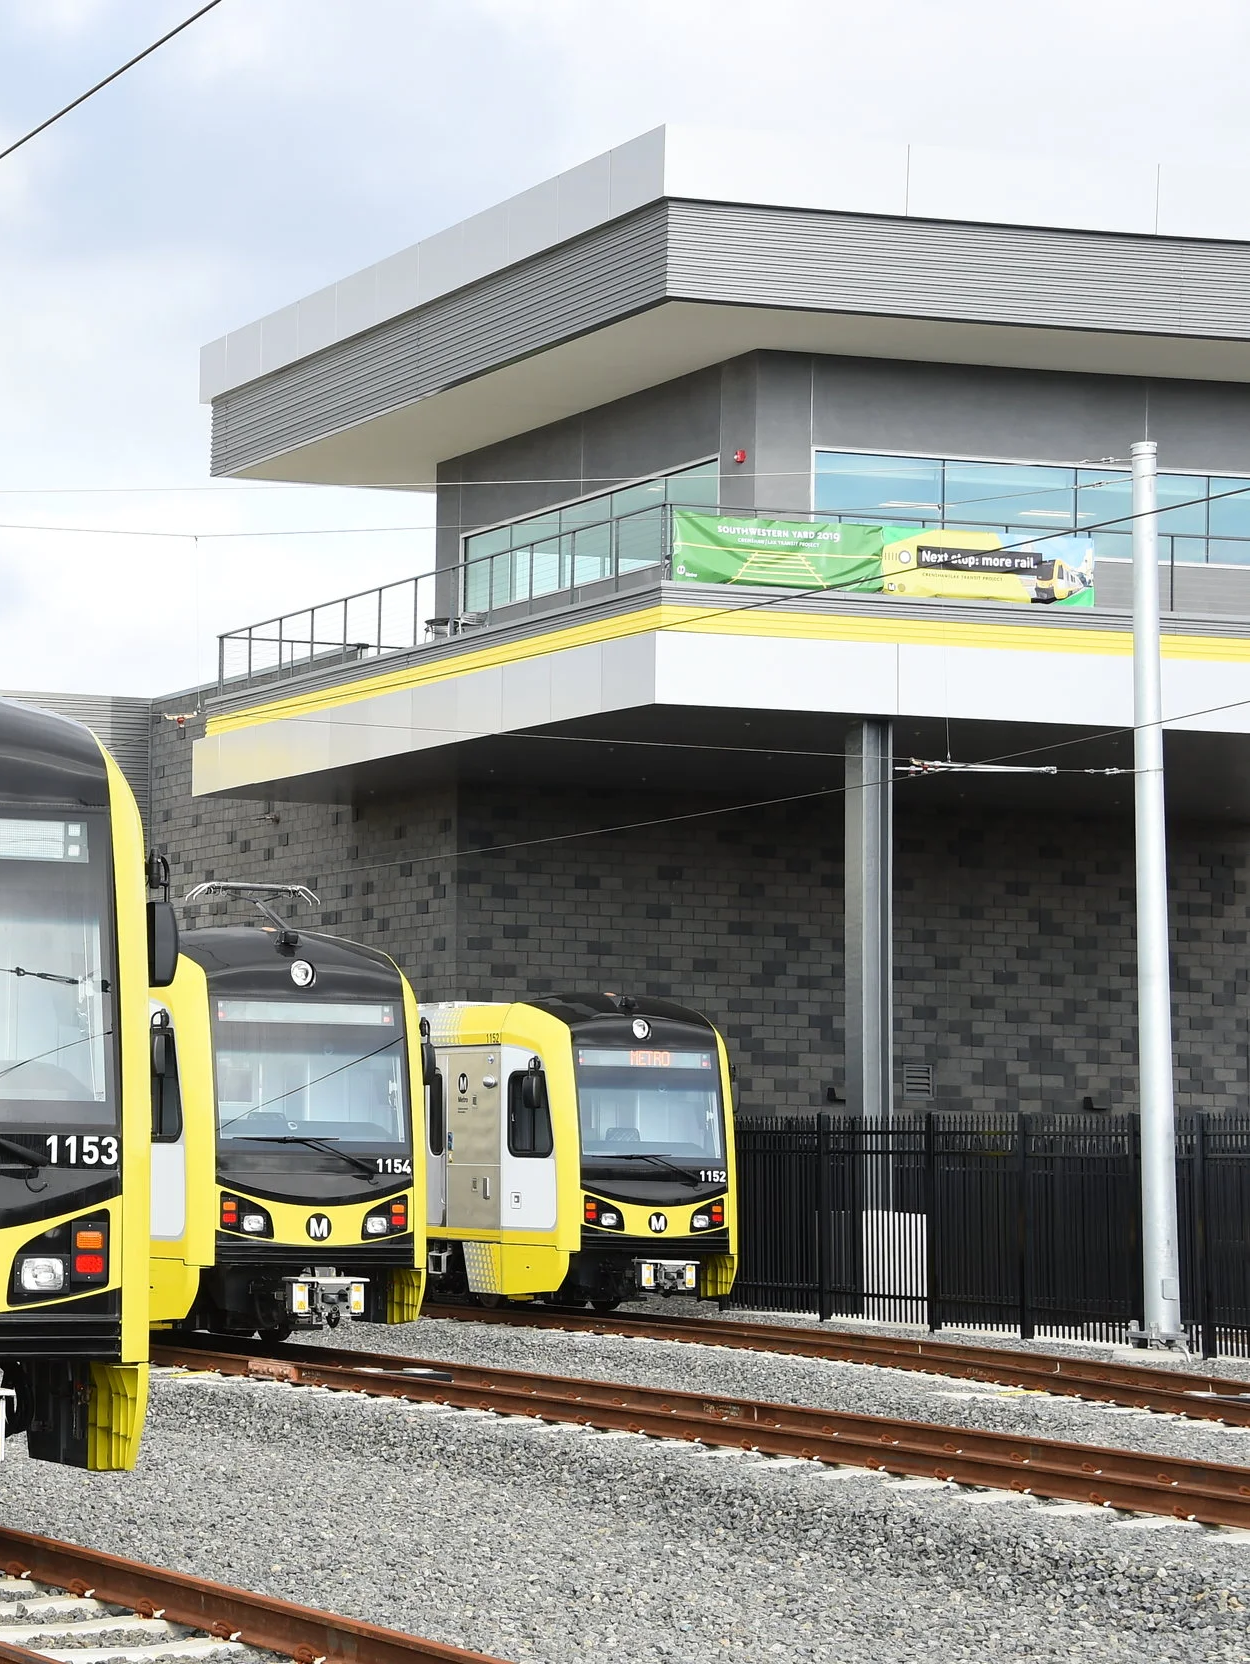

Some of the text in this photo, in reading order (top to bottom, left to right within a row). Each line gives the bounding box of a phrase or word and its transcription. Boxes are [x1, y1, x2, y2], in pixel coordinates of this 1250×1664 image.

[717, 525, 841, 543] SOUTHWESTERN YARD 2019
[921, 550, 948, 563] Next
[981, 556, 1012, 567] more
[1014, 556, 1038, 569] rail.
[630, 1050, 670, 1066] METRO
[46, 1134, 118, 1165] 1153
[376, 1158, 411, 1174] 1154
[699, 1170, 726, 1182] 1152
[309, 1217, 329, 1238] M
[650, 1215, 666, 1231] M
